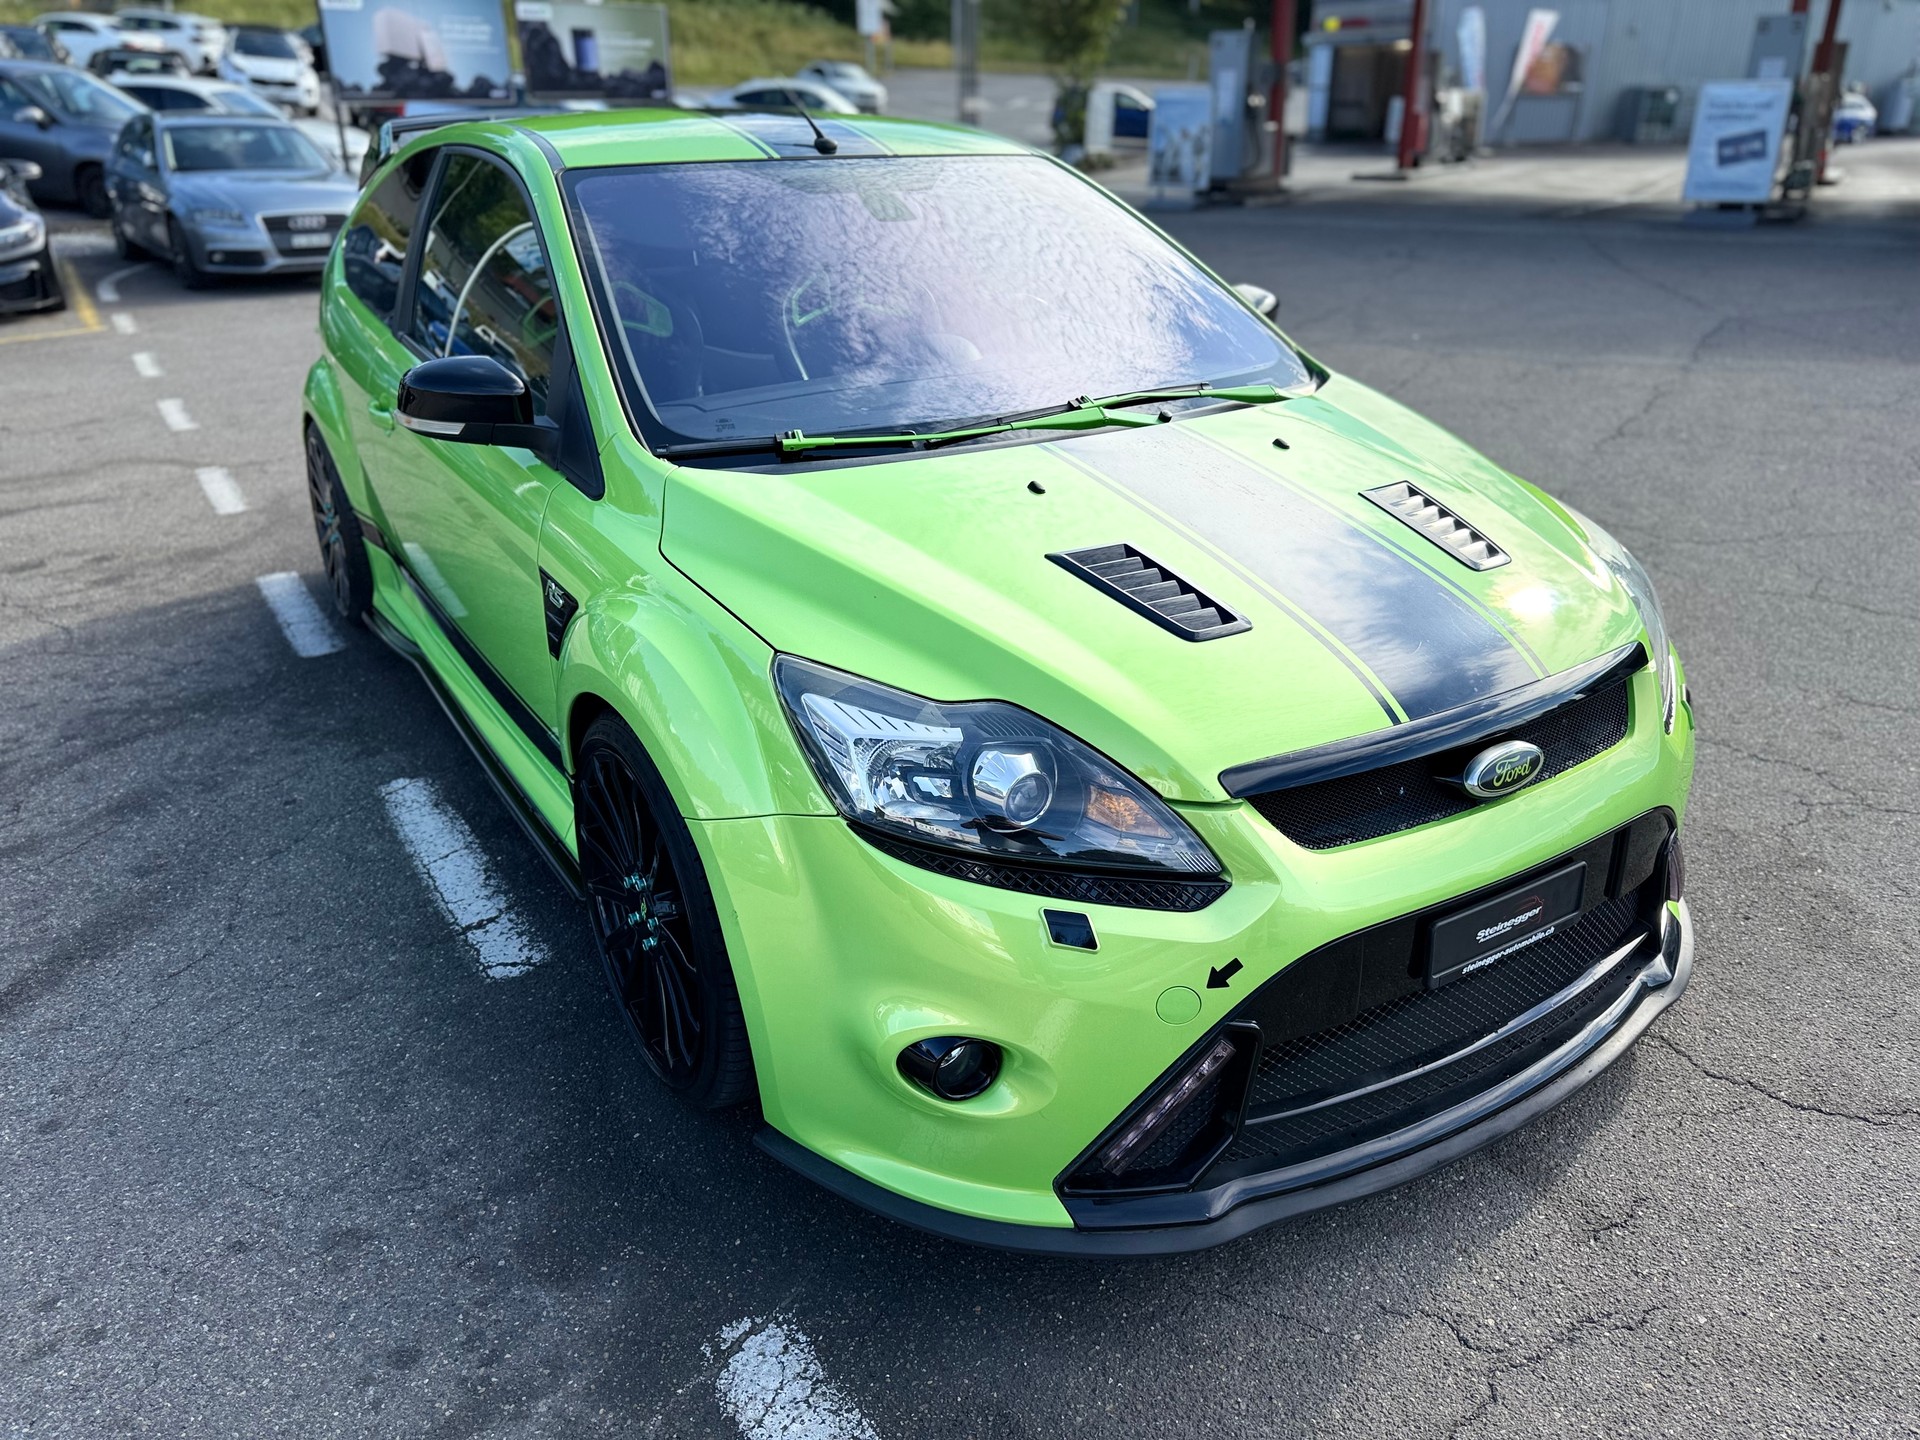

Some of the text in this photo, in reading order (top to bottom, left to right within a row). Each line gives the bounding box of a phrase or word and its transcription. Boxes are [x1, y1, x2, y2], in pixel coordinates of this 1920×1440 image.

[545, 580, 565, 609] RS
[1493, 755, 1532, 787] Ford
[1475, 905, 1543, 940] Steinegger
[1461, 926, 1555, 975] steinegger-automobile.ch
